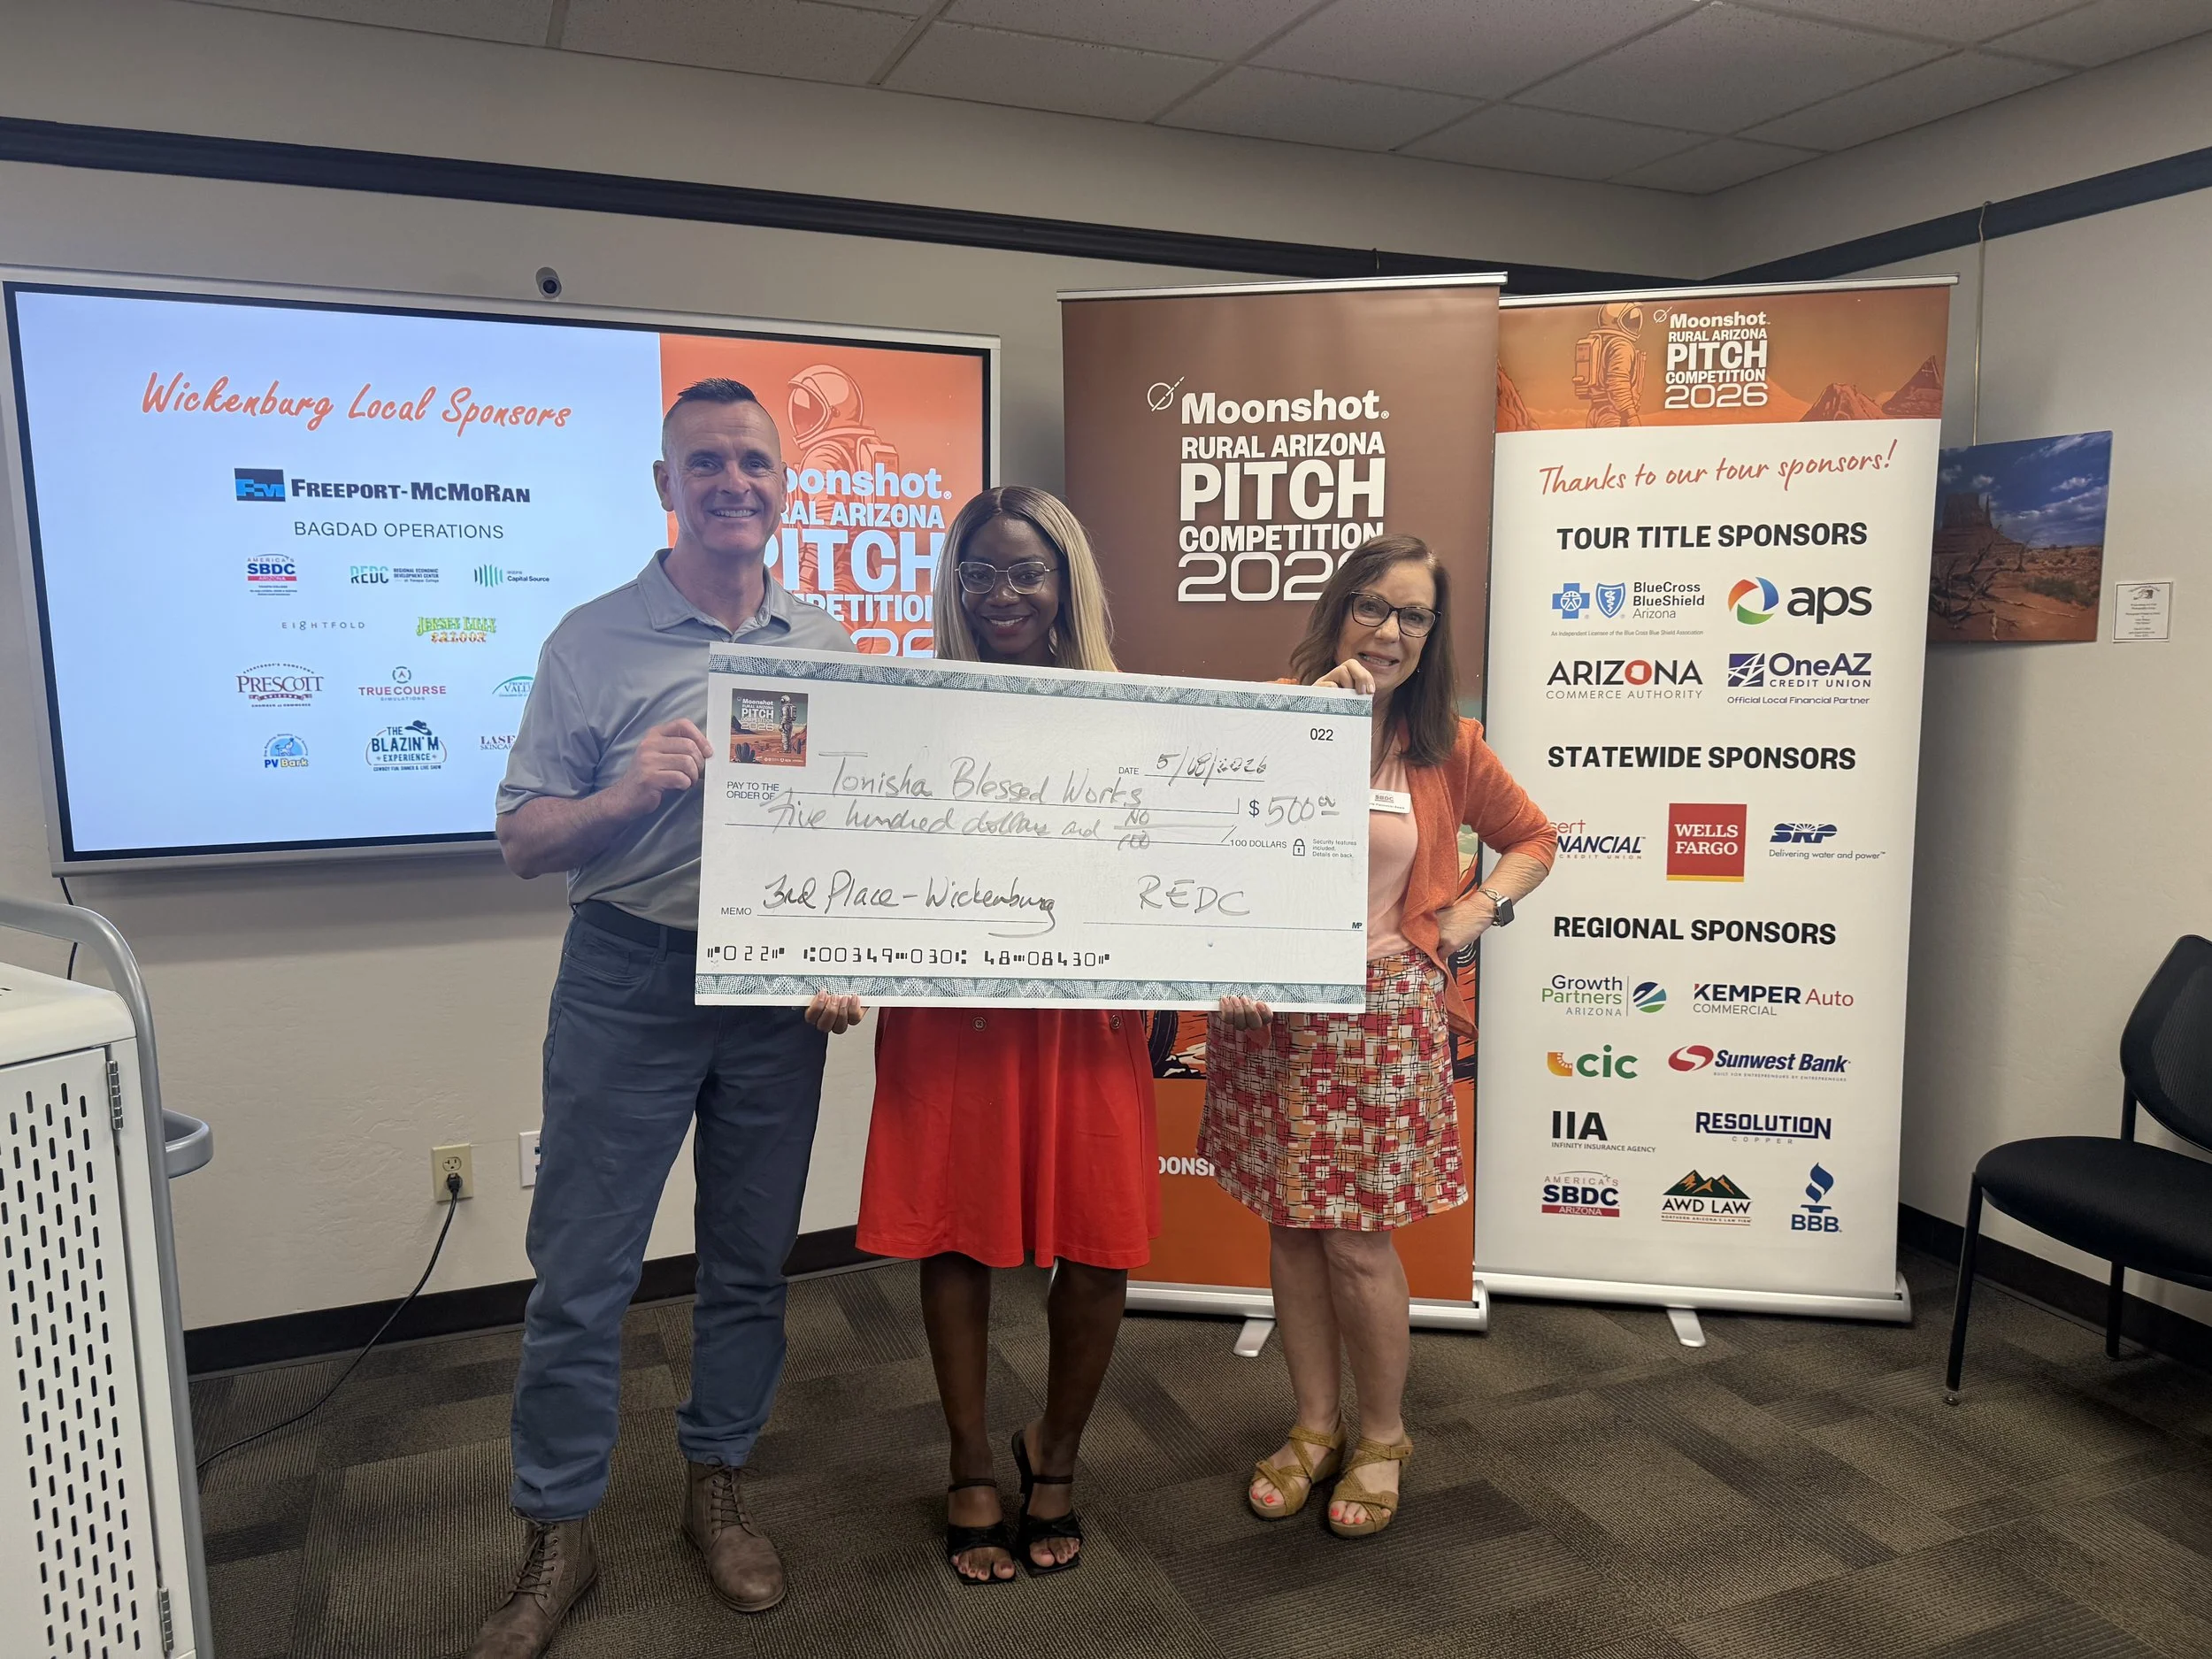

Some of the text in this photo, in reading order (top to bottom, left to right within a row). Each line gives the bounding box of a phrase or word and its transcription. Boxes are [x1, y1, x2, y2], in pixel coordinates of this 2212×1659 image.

[1670, 311, 1768, 328] Moonshot
[1669, 328, 1768, 342] RURAL ARIZONA
[1667, 340, 1768, 371] PITCH
[1665, 369, 1766, 384] COMPETITION
[142, 372, 572, 436] Wickenburg Local Sponsors
[1664, 382, 1769, 409] 2026
[1181, 431, 1386, 459] RURAL ARIZONA
[1539, 438, 1899, 495] Thanks to our tour sponsors!
[1180, 457, 1386, 521] PITCH
[831, 501, 945, 528] ARIZONA
[294, 521, 504, 540] BAGDAD OPERATIONS
[1179, 522, 1384, 552] COMPETITION
[1556, 521, 1867, 549] TOUR TITLE SPONSORS
[247, 563, 296, 575] SBDC
[350, 565, 389, 584] REDC
[1178, 551, 1355, 602] 202
[1633, 581, 1701, 593] BlueCross
[1633, 595, 1705, 607] BlueShield
[1787, 586, 1872, 625] aps
[1632, 608, 1677, 619] Arizona
[416, 617, 461, 636] JERSEY
[1547, 659, 1703, 686] ARIZONA
[1769, 652, 1872, 676] OneAZ
[235, 675, 325, 694] PRESCOTT
[358, 686, 447, 696] TRUE COURSE
[1825, 679, 1871, 687] UNION
[1546, 689, 1703, 699] COMMERCE AUTHORITY
[741, 708, 774, 718] PITCH
[387, 726, 403, 735] THE
[741, 722, 774, 731] 2026
[1310, 728, 1334, 741] 022
[372, 736, 439, 752] BLAZIN' M
[265, 757, 309, 768] PV Bark
[1548, 746, 1856, 770] STATEWIDE SPONSORS
[1118, 766, 1140, 775] DATE
[726, 781, 780, 792] PAY TO THE
[818, 752, 1142, 808] Tonisha Blessed Works
[726, 790, 775, 801] ORDER OF
[1249, 800, 1260, 818] $
[846, 800, 955, 833] hundred
[1062, 819, 1100, 840] and
[1673, 824, 1739, 839] WELLS
[1770, 823, 1837, 843] SRP
[1248, 841, 1287, 849] DOLLARS
[1674, 841, 1739, 856] FARGO
[1770, 849, 1809, 860] Delivering
[1837, 850, 1854, 859] and
[764, 870, 1056, 938] 3rd Place Wickenburg
[1138, 875, 1249, 917] REDC
[721, 907, 752, 916] MEMO
[1554, 917, 1837, 945] REGIONAL SPONSORS
[1551, 975, 1623, 991] Growth
[1542, 988, 1622, 1005] Partners
[1694, 983, 1855, 1007] KEMPER Auto
[1565, 1007, 1622, 1017] ARIZONA
[1693, 1003, 1778, 1016] COMMERCIAL
[1576, 1044, 1639, 1079] cic
[1715, 1049, 1849, 1073] Sunwest Bank
[1552, 1110, 1609, 1141] IIA
[1695, 1111, 1832, 1140] RESOLUTION
[1732, 1135, 1793, 1144] COPPER
[1544, 1175, 1619, 1187] AMERICA'S
[1542, 1185, 1619, 1207] SBDC
[1558, 1206, 1602, 1216] ARIZONA
[1662, 1197, 1751, 1215] AWD LAW
[1791, 1213, 1839, 1233] BBB
